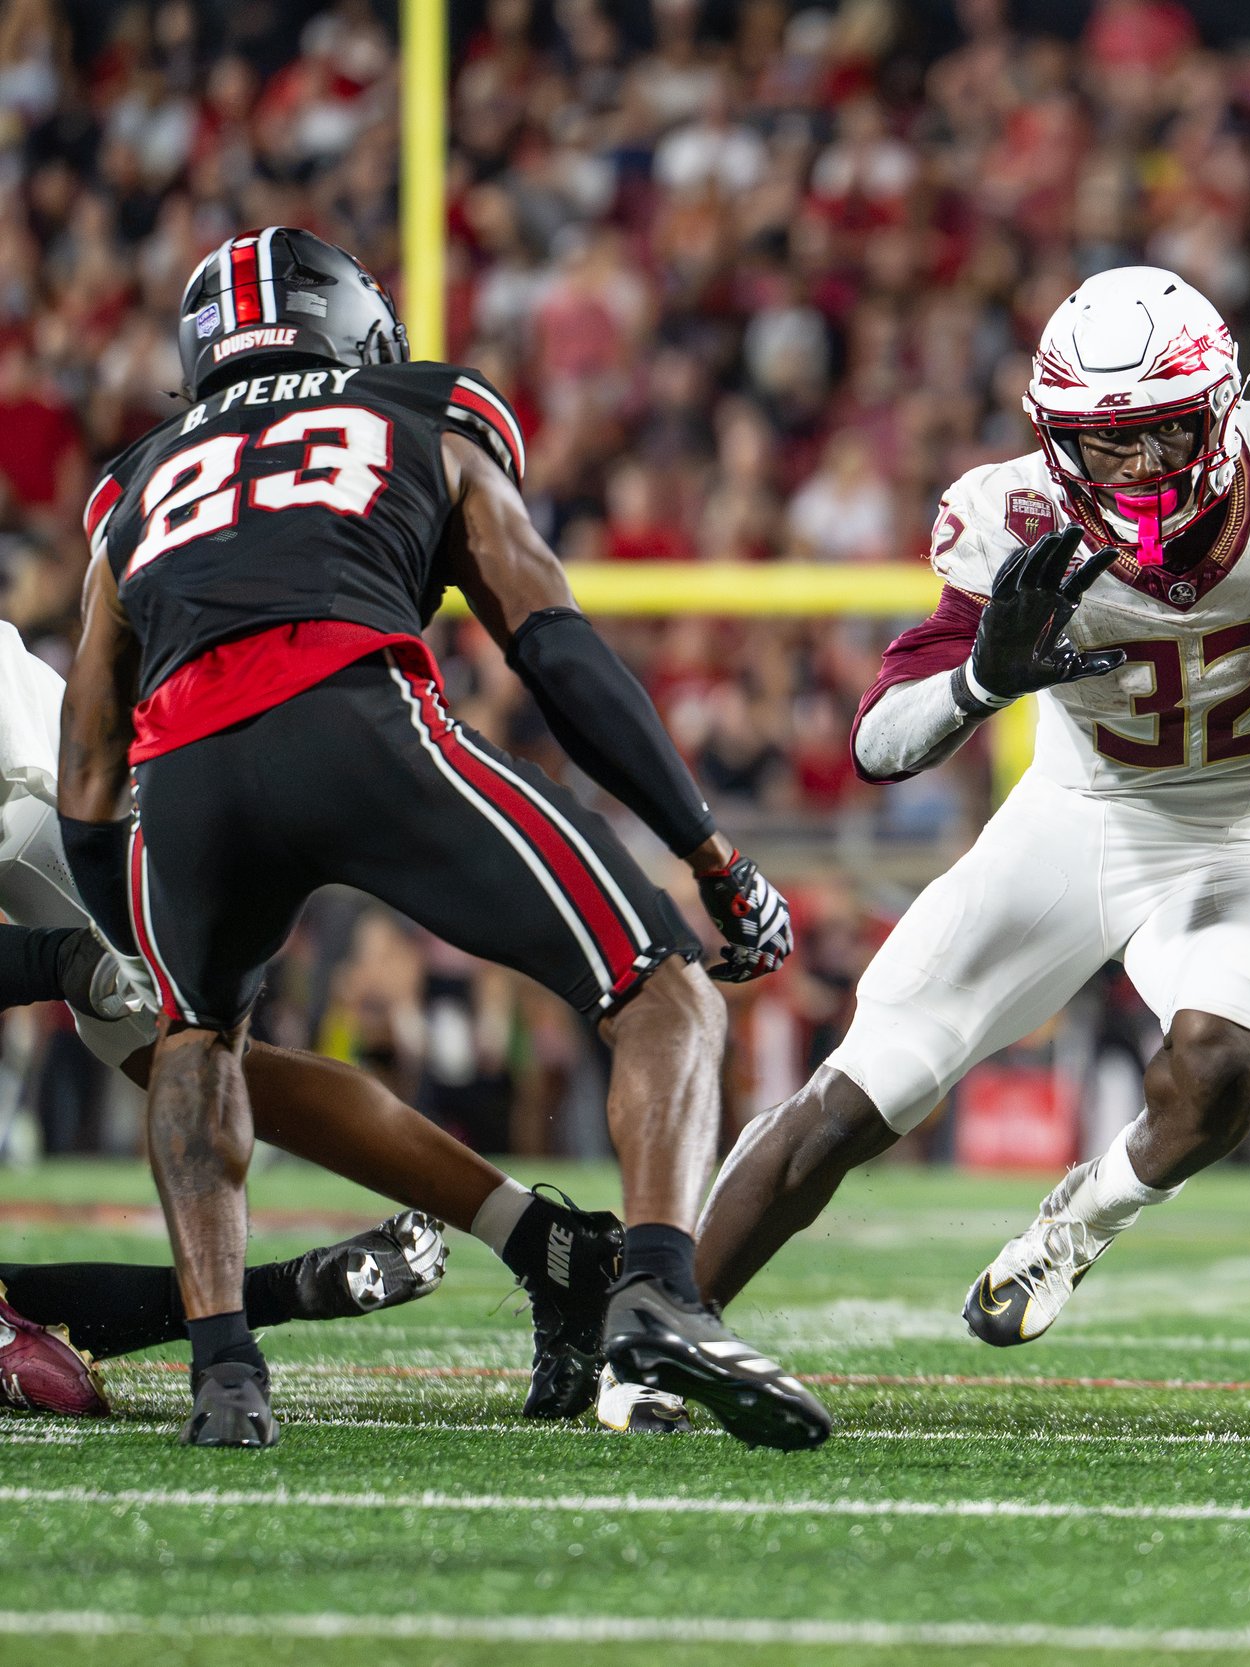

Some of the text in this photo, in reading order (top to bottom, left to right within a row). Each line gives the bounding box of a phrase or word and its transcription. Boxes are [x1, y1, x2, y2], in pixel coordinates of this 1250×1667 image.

[213, 328, 298, 364] LOUISVILLE
[179, 368, 361, 436] B. PERRY
[124, 405, 394, 581] 23
[931, 499, 967, 557] 2
[547, 1221, 574, 1289] NIKE
